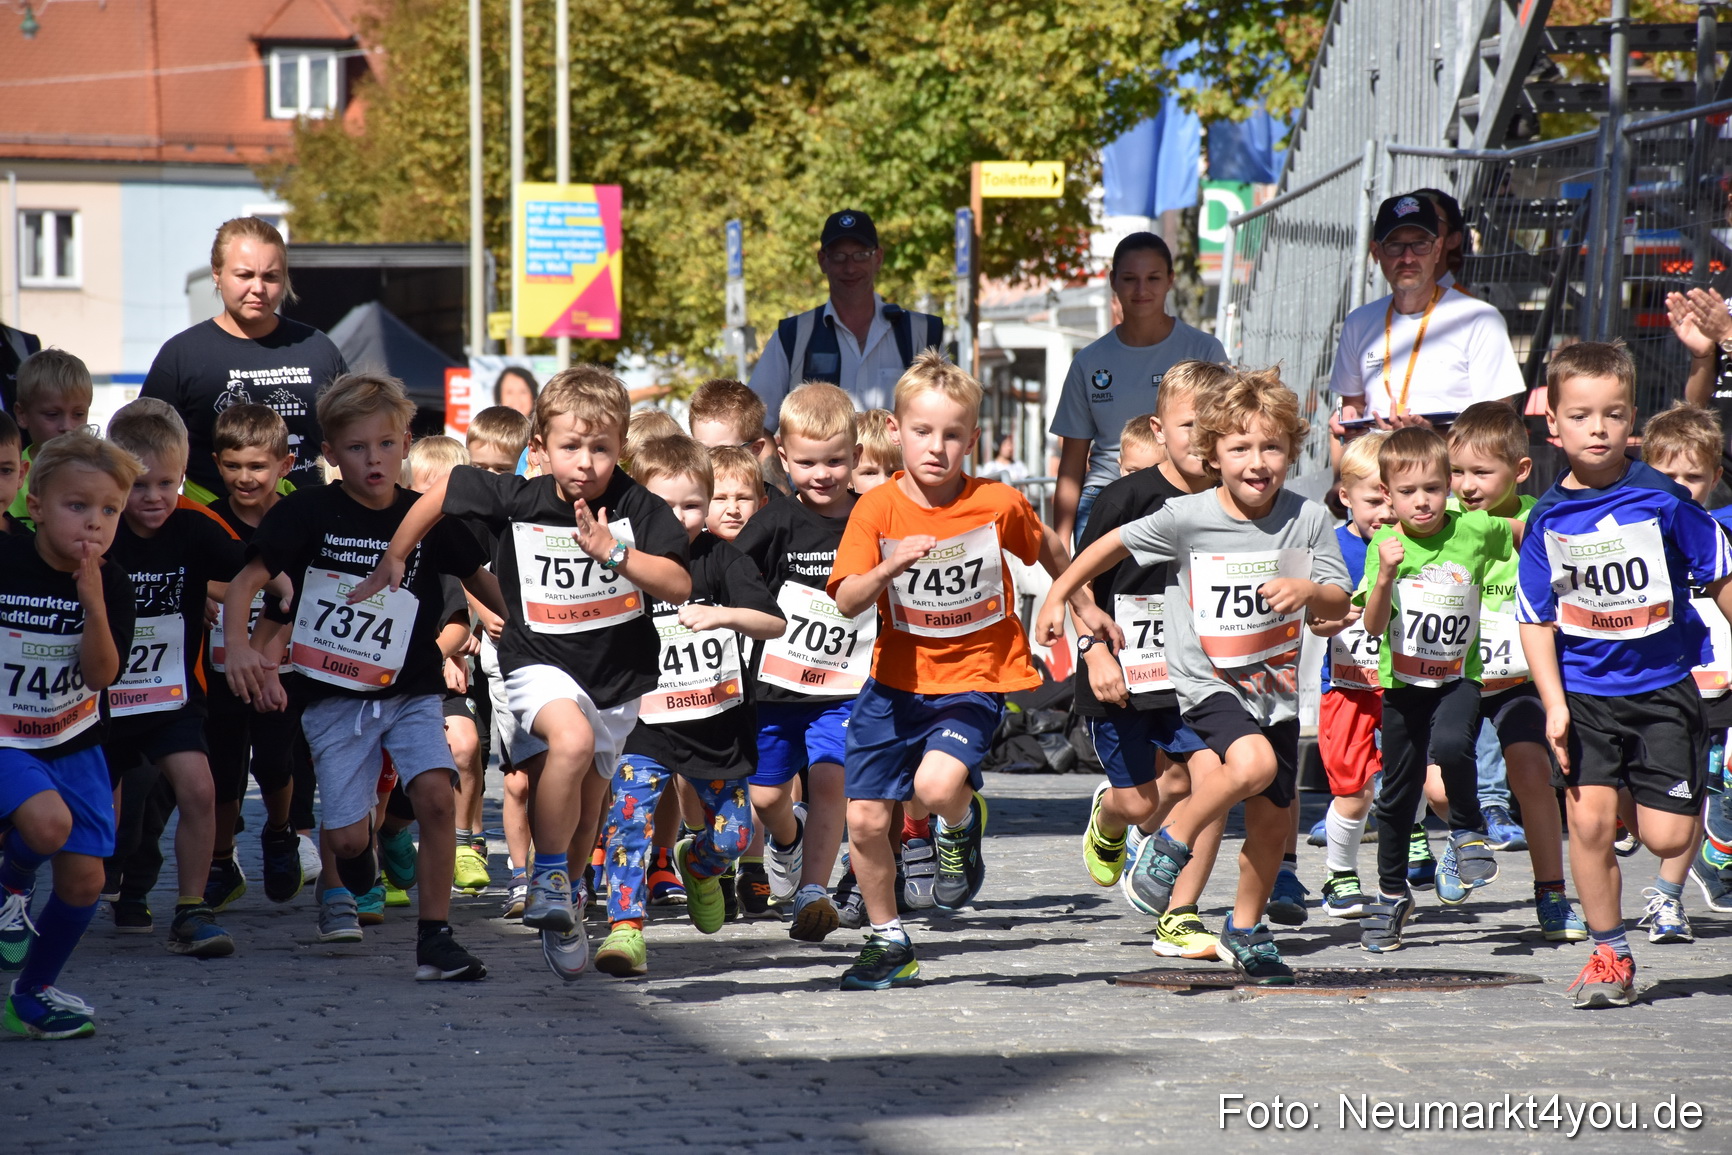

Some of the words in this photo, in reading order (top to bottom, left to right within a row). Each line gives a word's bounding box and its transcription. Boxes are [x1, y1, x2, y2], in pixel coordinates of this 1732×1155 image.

[984, 173, 1048, 186] Toiletten
[229, 366, 309, 379] Neumarkter
[1092, 392, 1113, 400] PARTL
[1570, 538, 1625, 557] BOCK
[320, 547, 379, 567] Stadtlauf
[1226, 560, 1279, 575] BOCK
[905, 557, 983, 596] 7437
[1562, 557, 1649, 596] 7400
[0, 594, 80, 612] eumarkter
[545, 592, 568, 601] PARTL
[569, 590, 606, 601] Neumarkt
[912, 599, 936, 607] PARTL
[938, 596, 972, 608] Neumarkt
[1423, 592, 1465, 607] BOCK
[1577, 596, 1597, 607] PARTL
[1598, 598, 1636, 608] Neumarkt
[546, 608, 601, 620] Lukas
[925, 611, 972, 627] Fabian
[1591, 614, 1634, 629] Anton
[313, 599, 394, 650] 7374
[1220, 623, 1245, 632] PARTL
[1246, 617, 1277, 630] Neumarkt
[1406, 609, 1470, 646] 7092
[787, 614, 859, 658] 7031
[313, 636, 336, 650] PARTL
[337, 642, 371, 659] Neumarkt
[1407, 645, 1428, 655] PARTL
[1429, 648, 1456, 657] Neumarkt
[661, 637, 723, 676] 419
[787, 649, 810, 661] PARTL
[810, 656, 840, 668] Neumarkt
[1141, 651, 1163, 660] PARTL
[321, 655, 360, 677] Louis
[1130, 666, 1167, 681] MAXIMIL
[1420, 661, 1448, 676] Leon
[679, 677, 713, 687] Neumarkt
[801, 669, 827, 685] Karl
[110, 691, 148, 706] Oliver
[665, 692, 716, 710] Bastian
[12, 703, 39, 713] PARTL
[40, 699, 75, 714] Neumarkt
[13, 710, 79, 735] Johannes
[950, 731, 968, 745] JAKO
[1668, 790, 1692, 799] adidas
